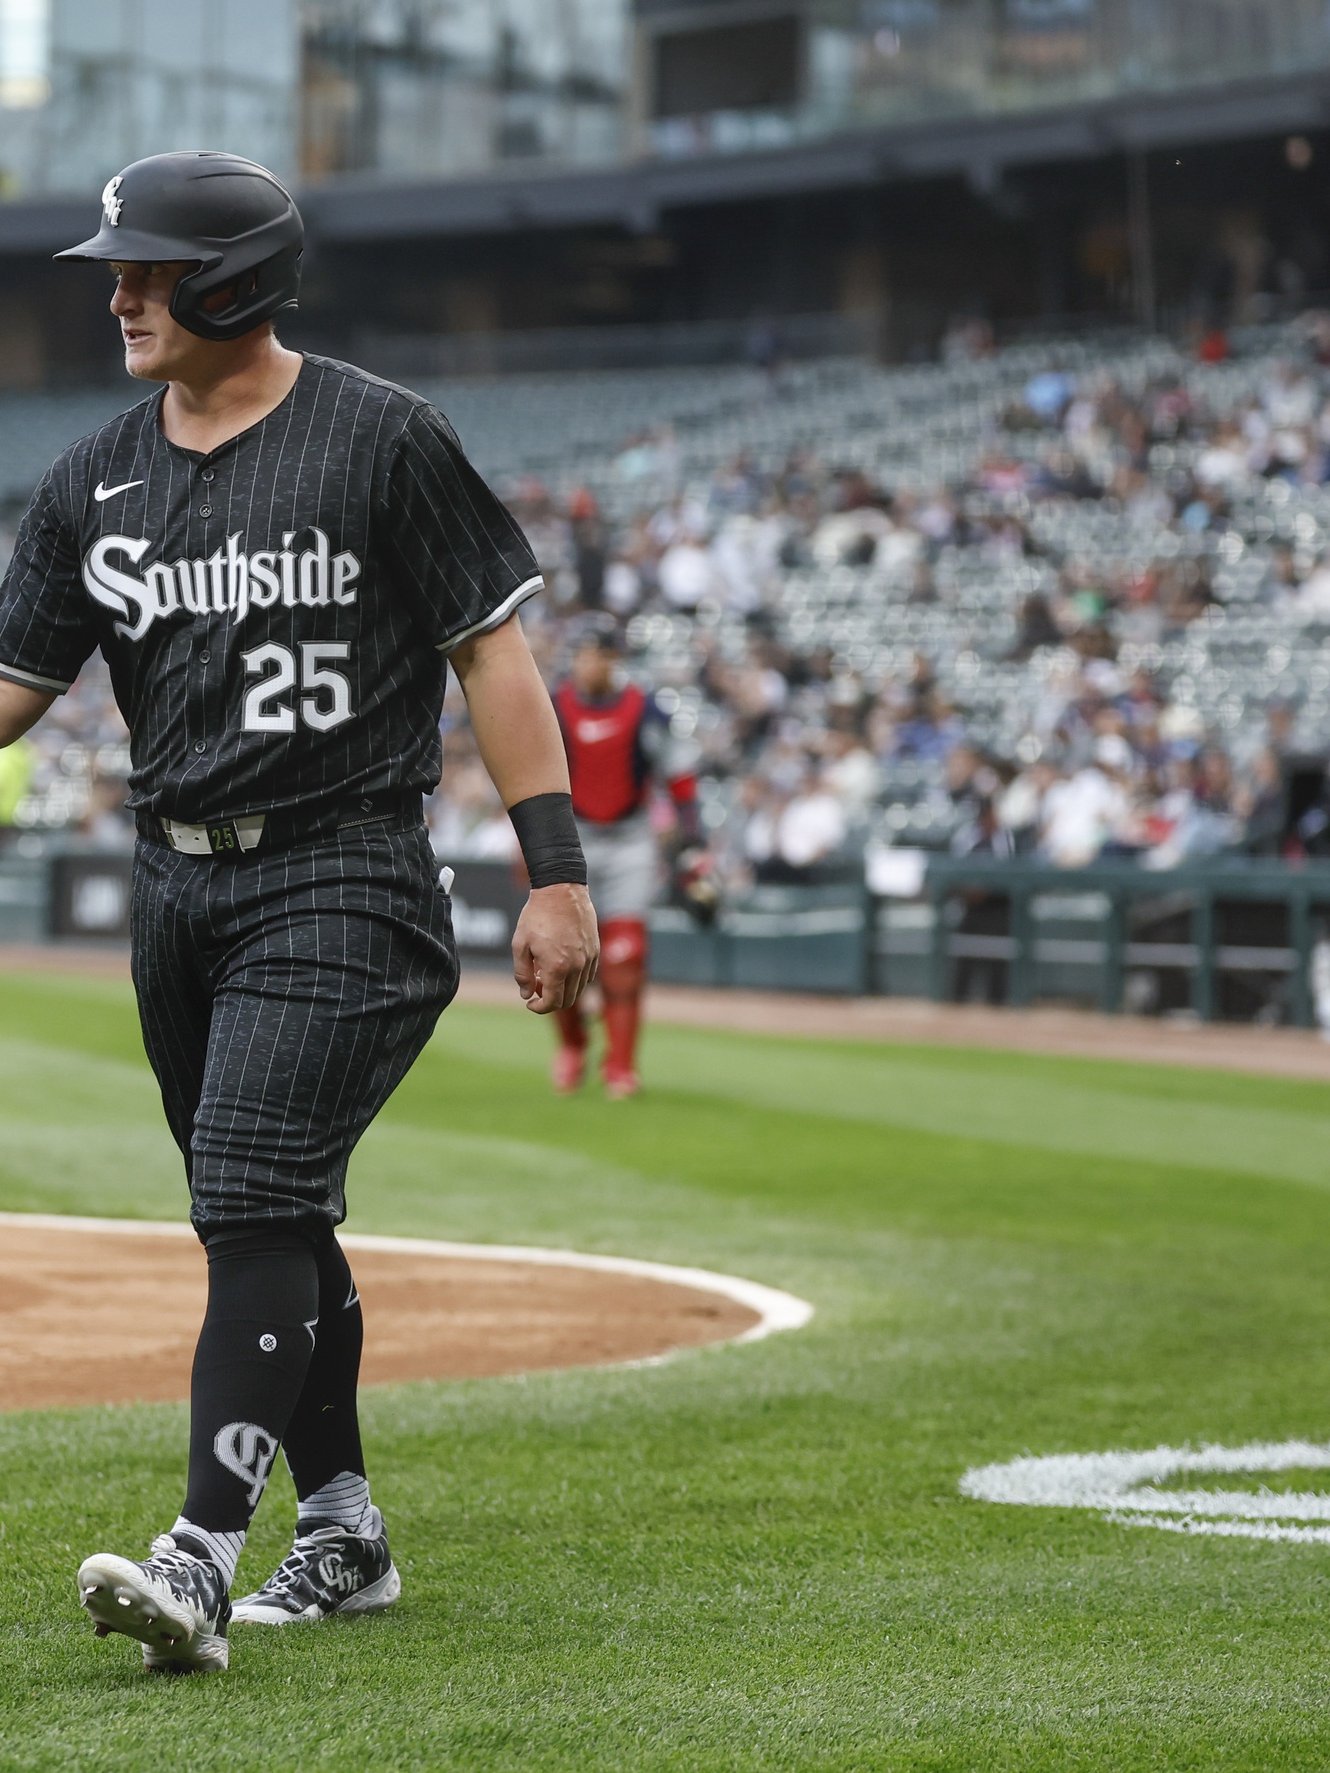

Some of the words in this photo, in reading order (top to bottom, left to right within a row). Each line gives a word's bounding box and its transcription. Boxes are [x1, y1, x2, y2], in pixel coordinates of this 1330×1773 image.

[82, 525, 361, 642] Southside
[239, 640, 357, 733] 25
[211, 827, 235, 850] 25
